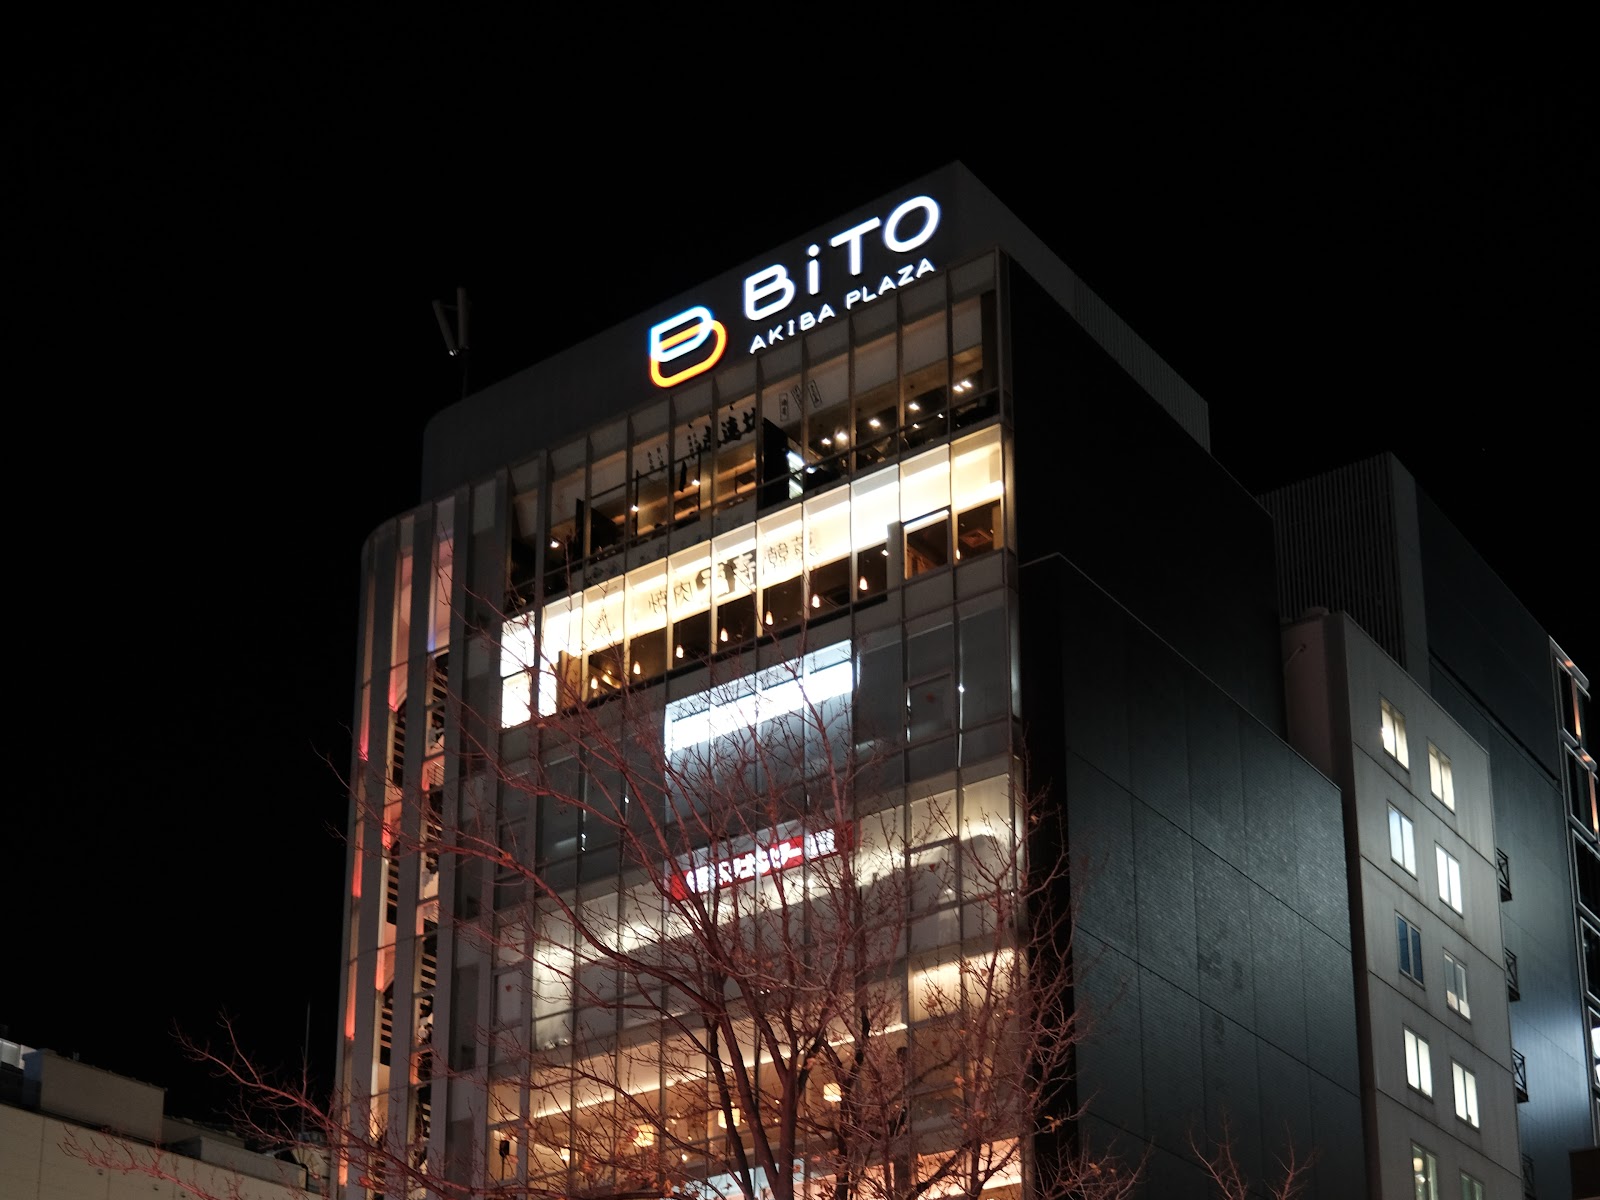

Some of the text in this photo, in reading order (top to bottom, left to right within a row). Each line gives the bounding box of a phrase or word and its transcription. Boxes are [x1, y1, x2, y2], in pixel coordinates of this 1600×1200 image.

[744, 195, 941, 321] BiTO
[750, 258, 935, 355] AKIBA PLAZA
